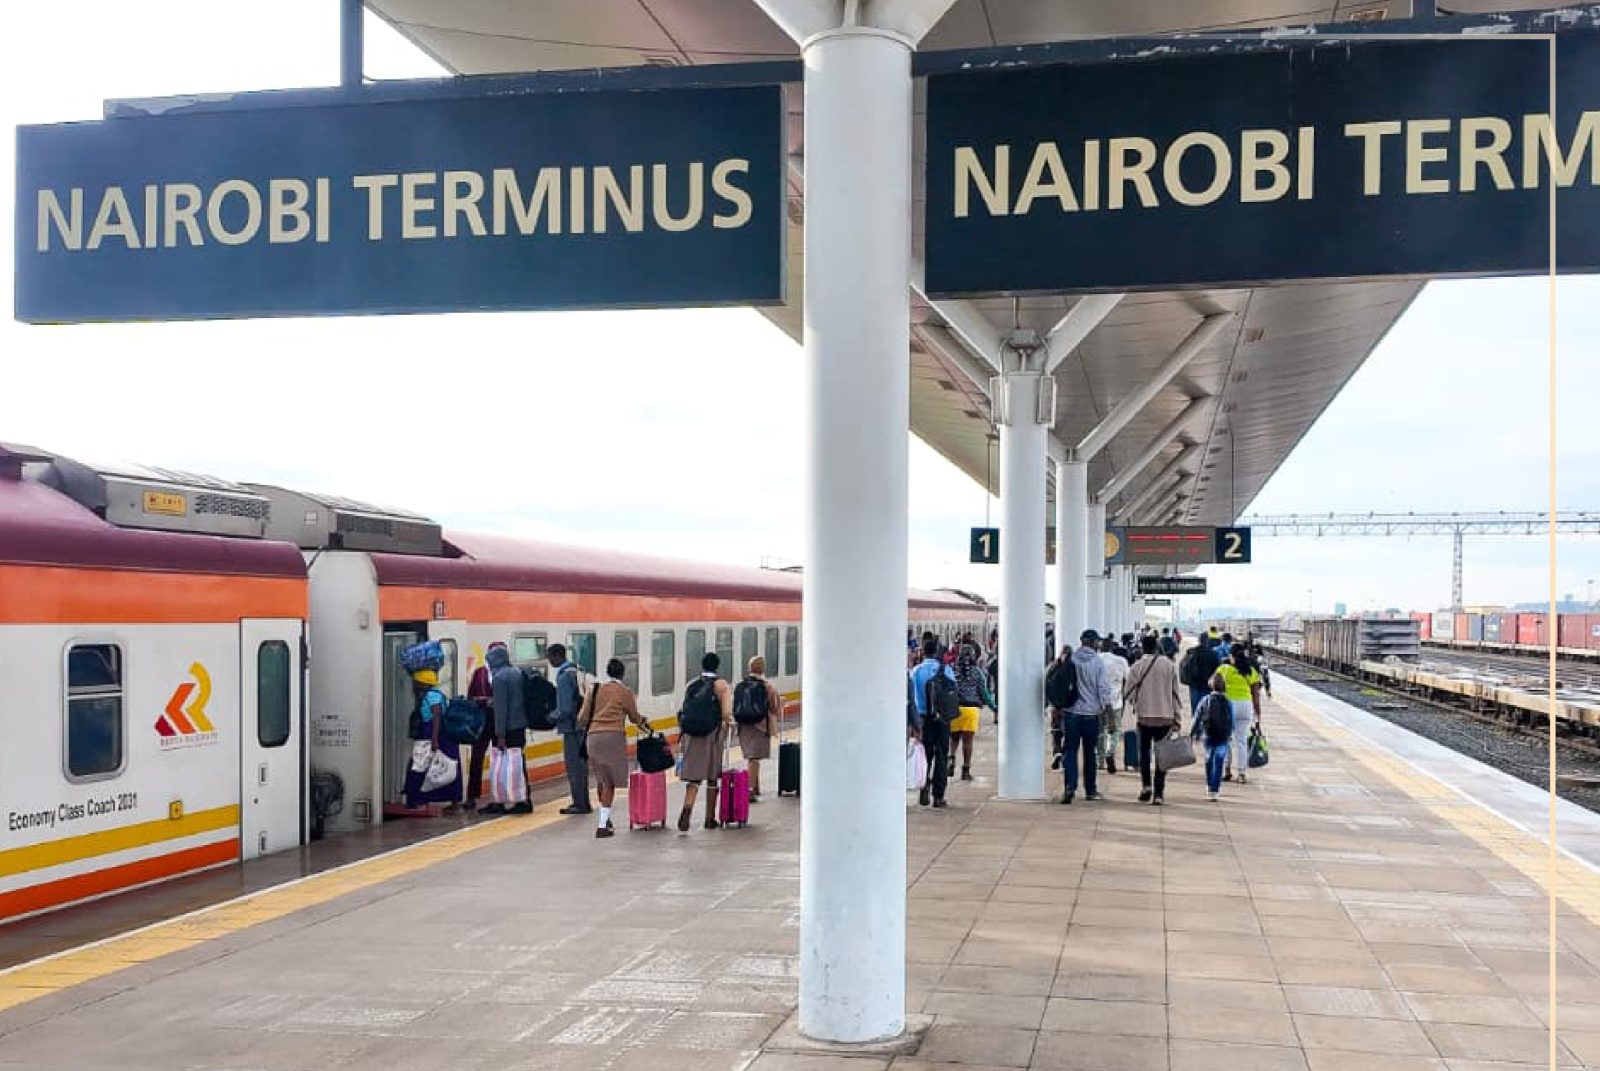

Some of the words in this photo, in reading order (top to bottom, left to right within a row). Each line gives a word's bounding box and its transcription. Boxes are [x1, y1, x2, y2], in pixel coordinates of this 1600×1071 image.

[955, 126, 1316, 219] NAIROBI
[1344, 110, 1600, 197] TERM
[36, 177, 330, 253] NAIROBI
[352, 158, 753, 241] TERMINUS
[978, 533, 991, 558] 1
[1224, 532, 1243, 559] 2
[9, 808, 56, 831] Economy
[58, 803, 85, 821] Class
[87, 796, 116, 816] Coach
